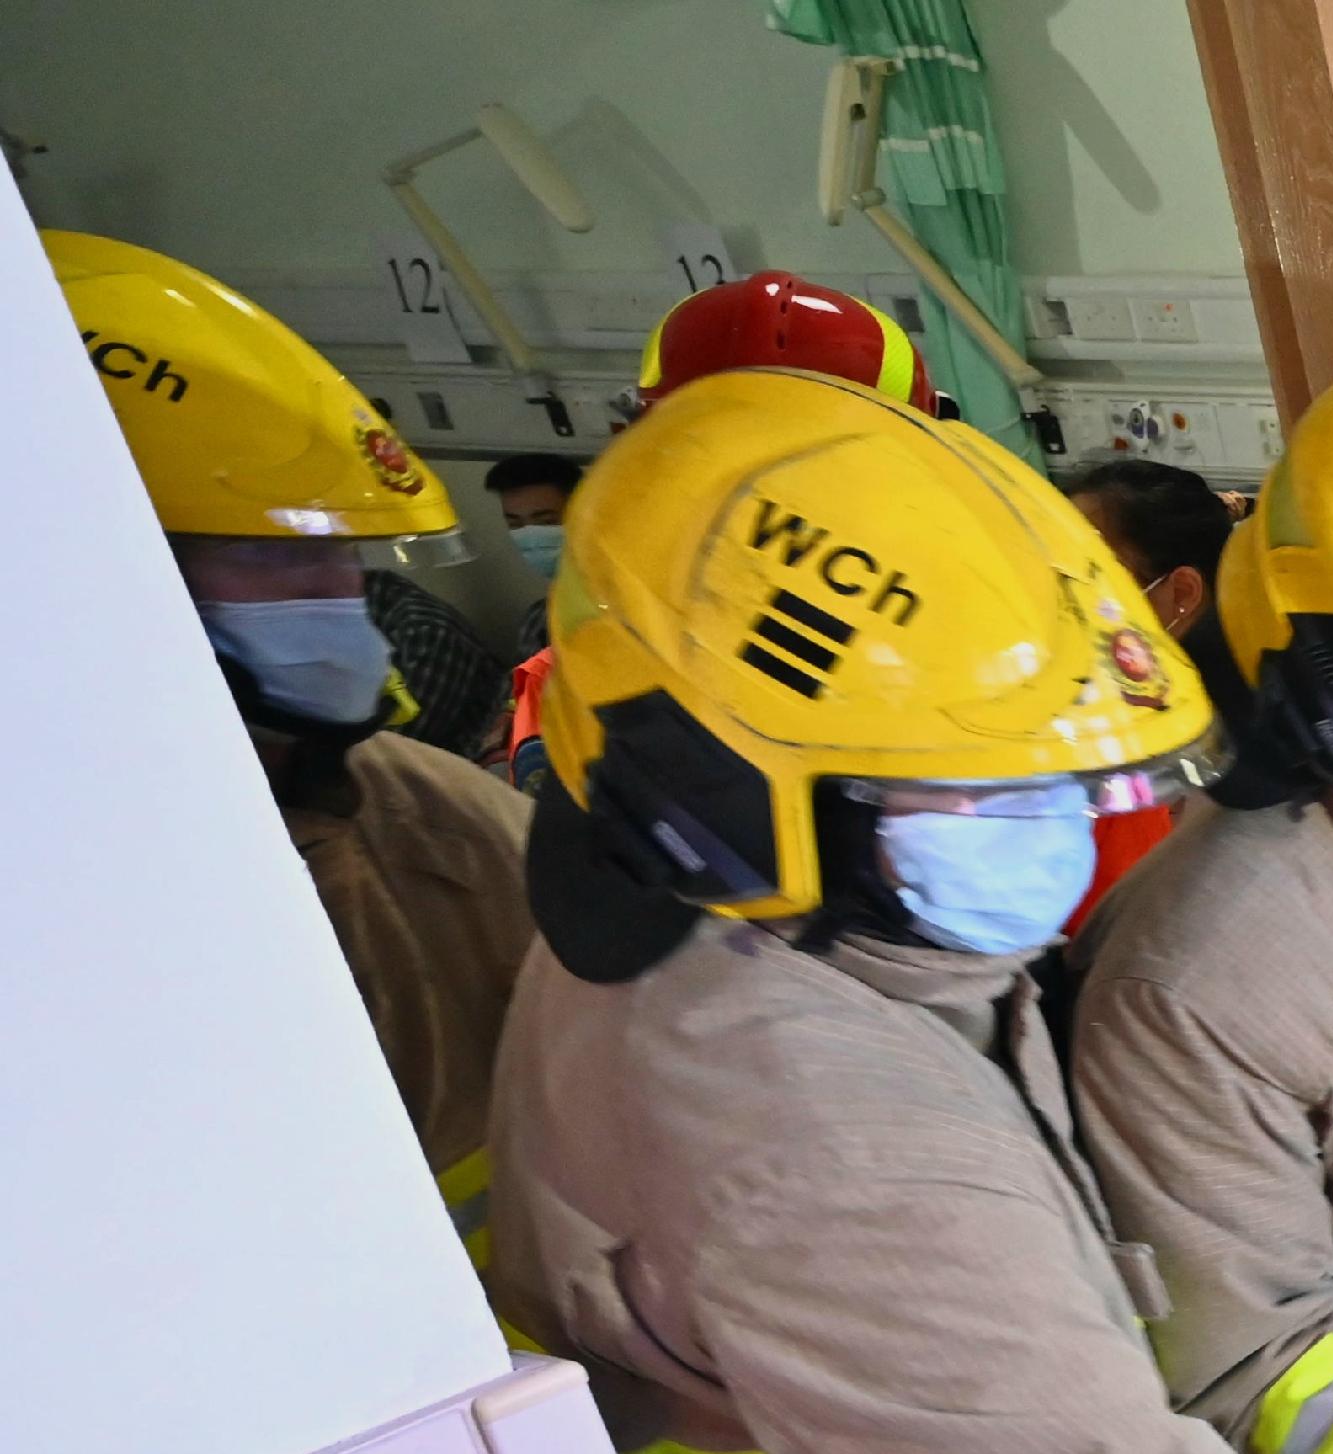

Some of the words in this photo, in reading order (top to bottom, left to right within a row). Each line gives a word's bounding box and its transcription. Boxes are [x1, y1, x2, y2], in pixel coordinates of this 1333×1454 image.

[388, 257, 441, 314] 12
[82, 330, 190, 403] Ch
[747, 498, 922, 627] WCh
